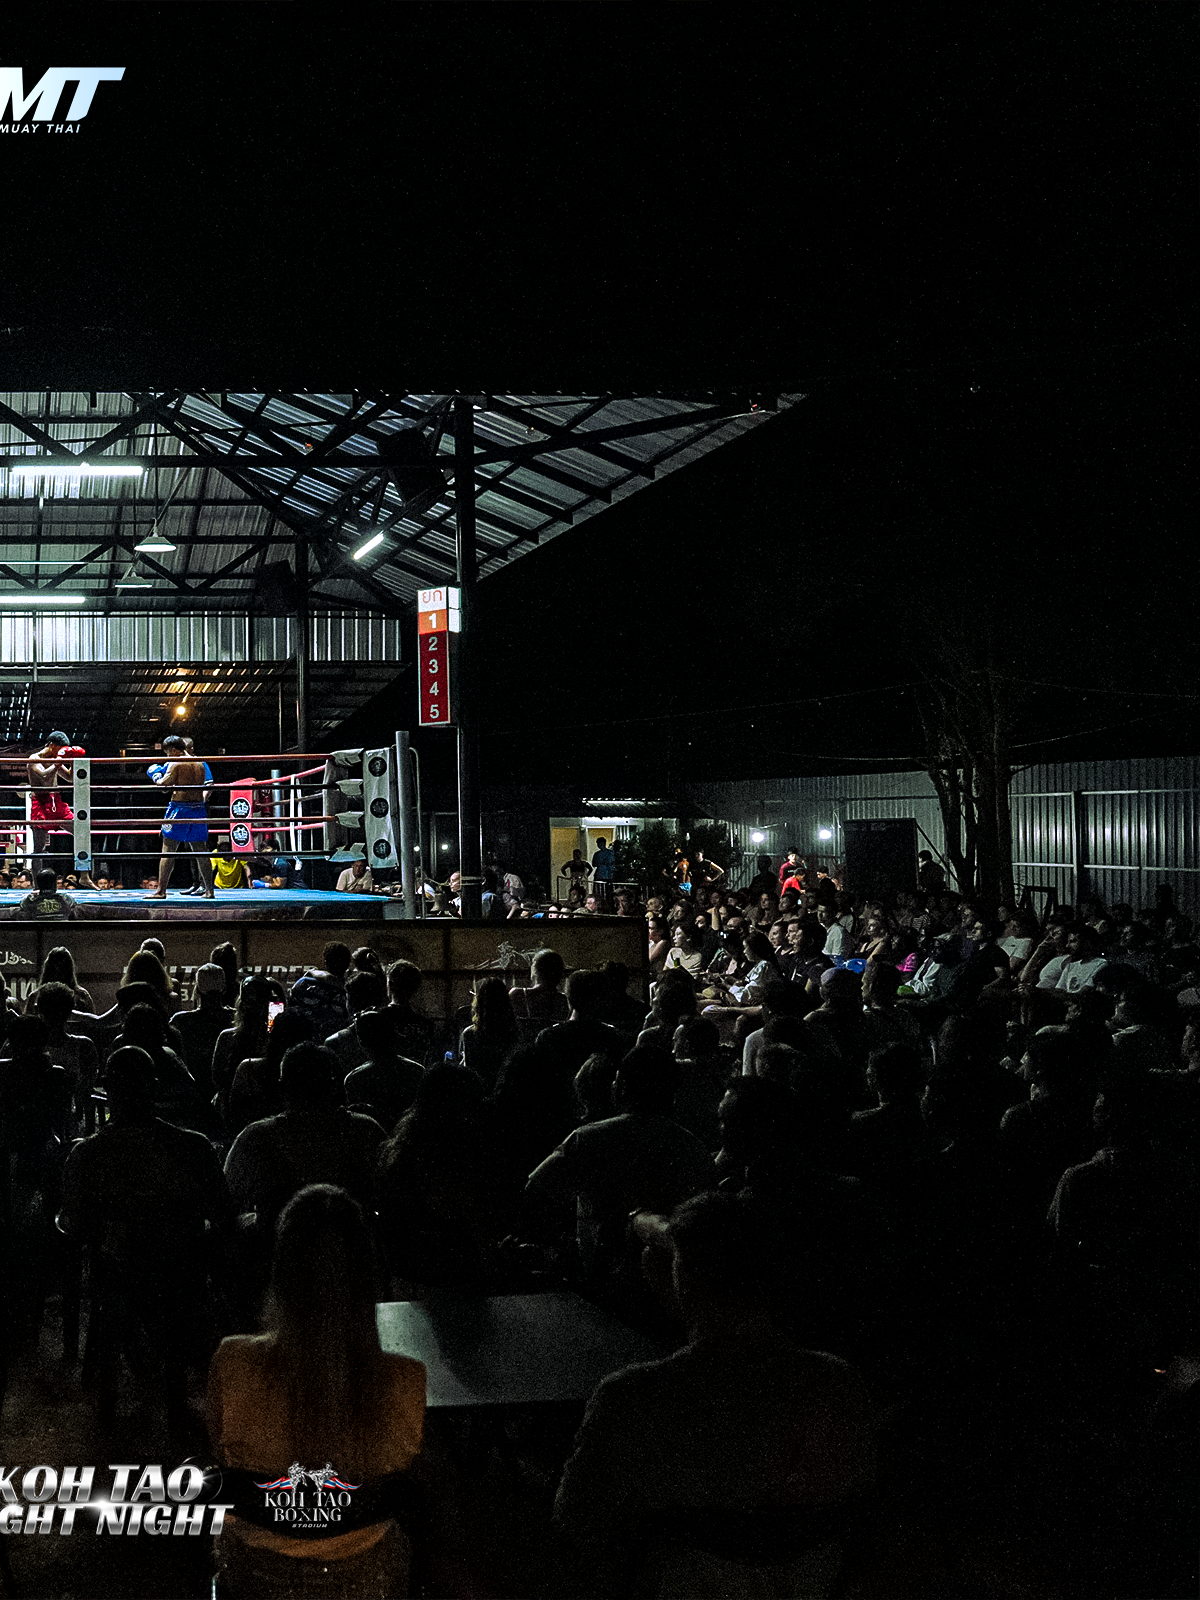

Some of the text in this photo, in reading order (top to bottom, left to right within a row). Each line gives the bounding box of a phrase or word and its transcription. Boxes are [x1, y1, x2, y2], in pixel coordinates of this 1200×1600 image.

[428, 612, 437, 629] 1
[428, 636, 438, 652] 2
[428, 659, 439, 674] 3
[429, 681, 439, 696] 4
[429, 704, 440, 719] 5
